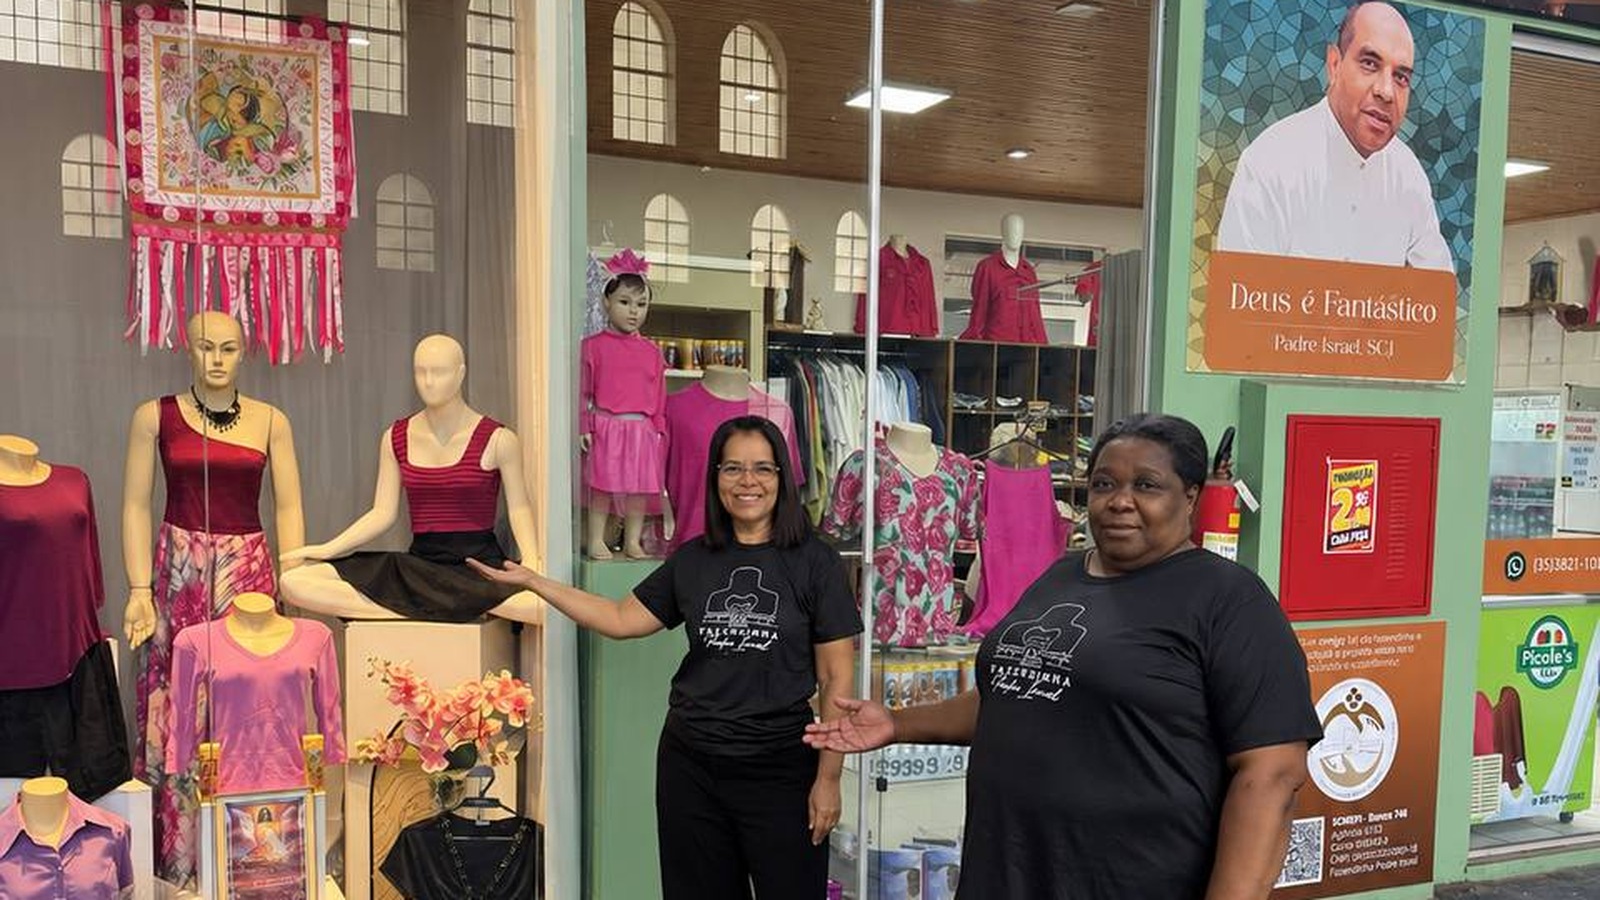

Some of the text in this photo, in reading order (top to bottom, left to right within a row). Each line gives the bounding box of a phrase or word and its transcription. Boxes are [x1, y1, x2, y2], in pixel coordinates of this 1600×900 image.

[1231, 282, 1437, 323] Deus é Fantástico
[1274, 334, 1317, 352] Padre
[1367, 339, 1394, 357] SCJ
[1522, 647, 1573, 666] Picole's
